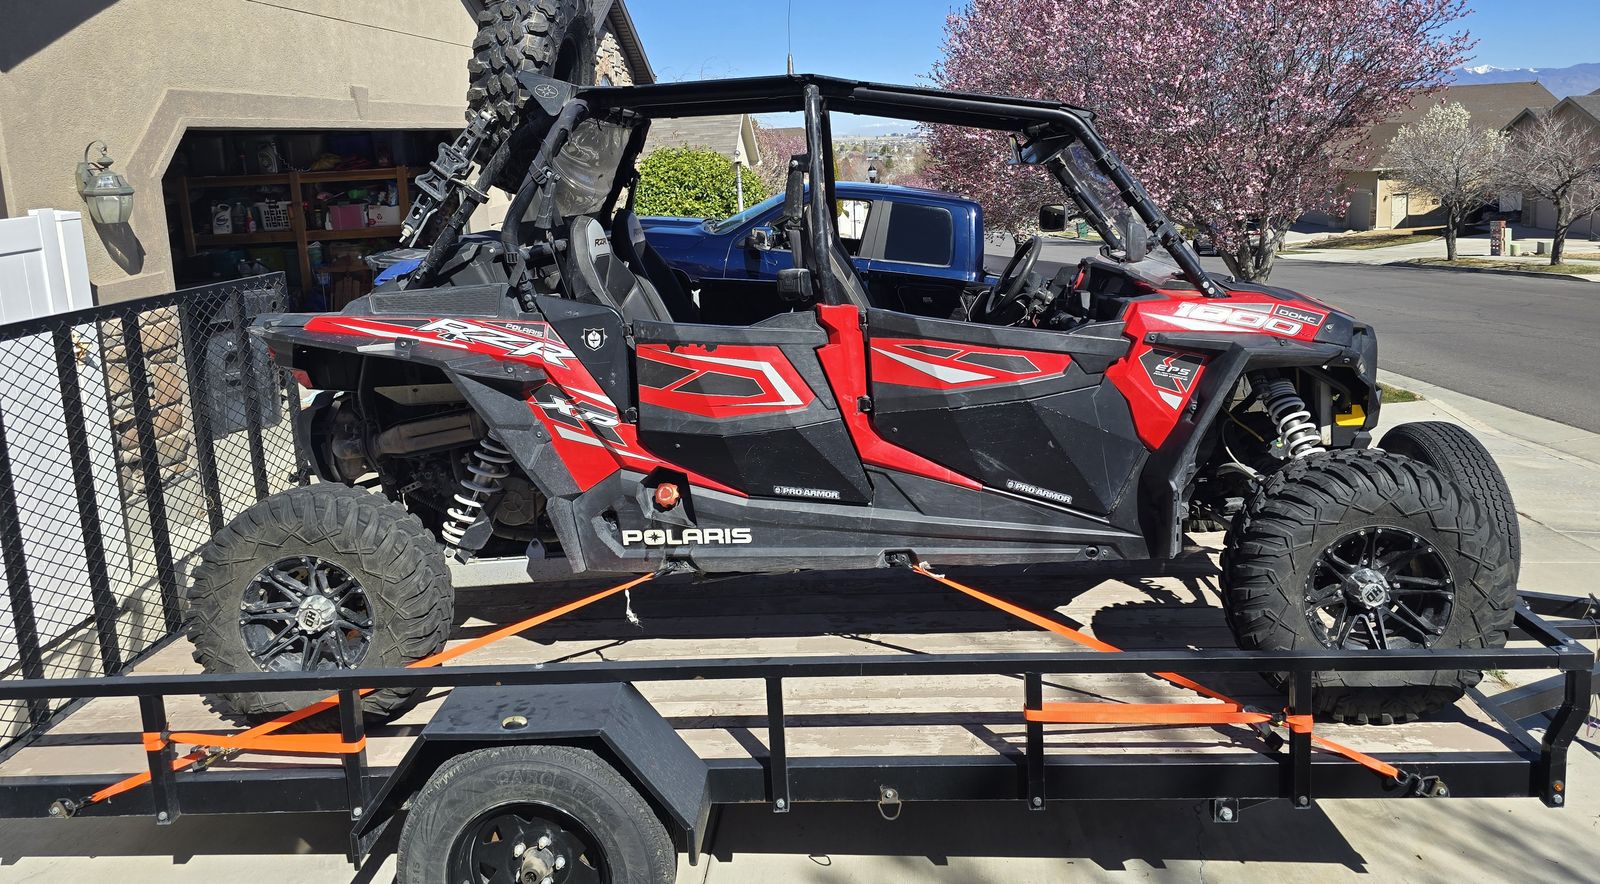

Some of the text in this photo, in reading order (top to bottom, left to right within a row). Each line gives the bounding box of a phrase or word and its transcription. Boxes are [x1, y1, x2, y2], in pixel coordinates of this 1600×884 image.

[1278, 308, 1317, 324] DOHC
[505, 322, 544, 338] POLARIS
[413, 318, 578, 370] RZR
[1155, 364, 1191, 376] EPS
[782, 487, 839, 499] PRO ARMOR
[1015, 482, 1072, 503] PRO ARMOR
[621, 528, 753, 546] POLARIS
